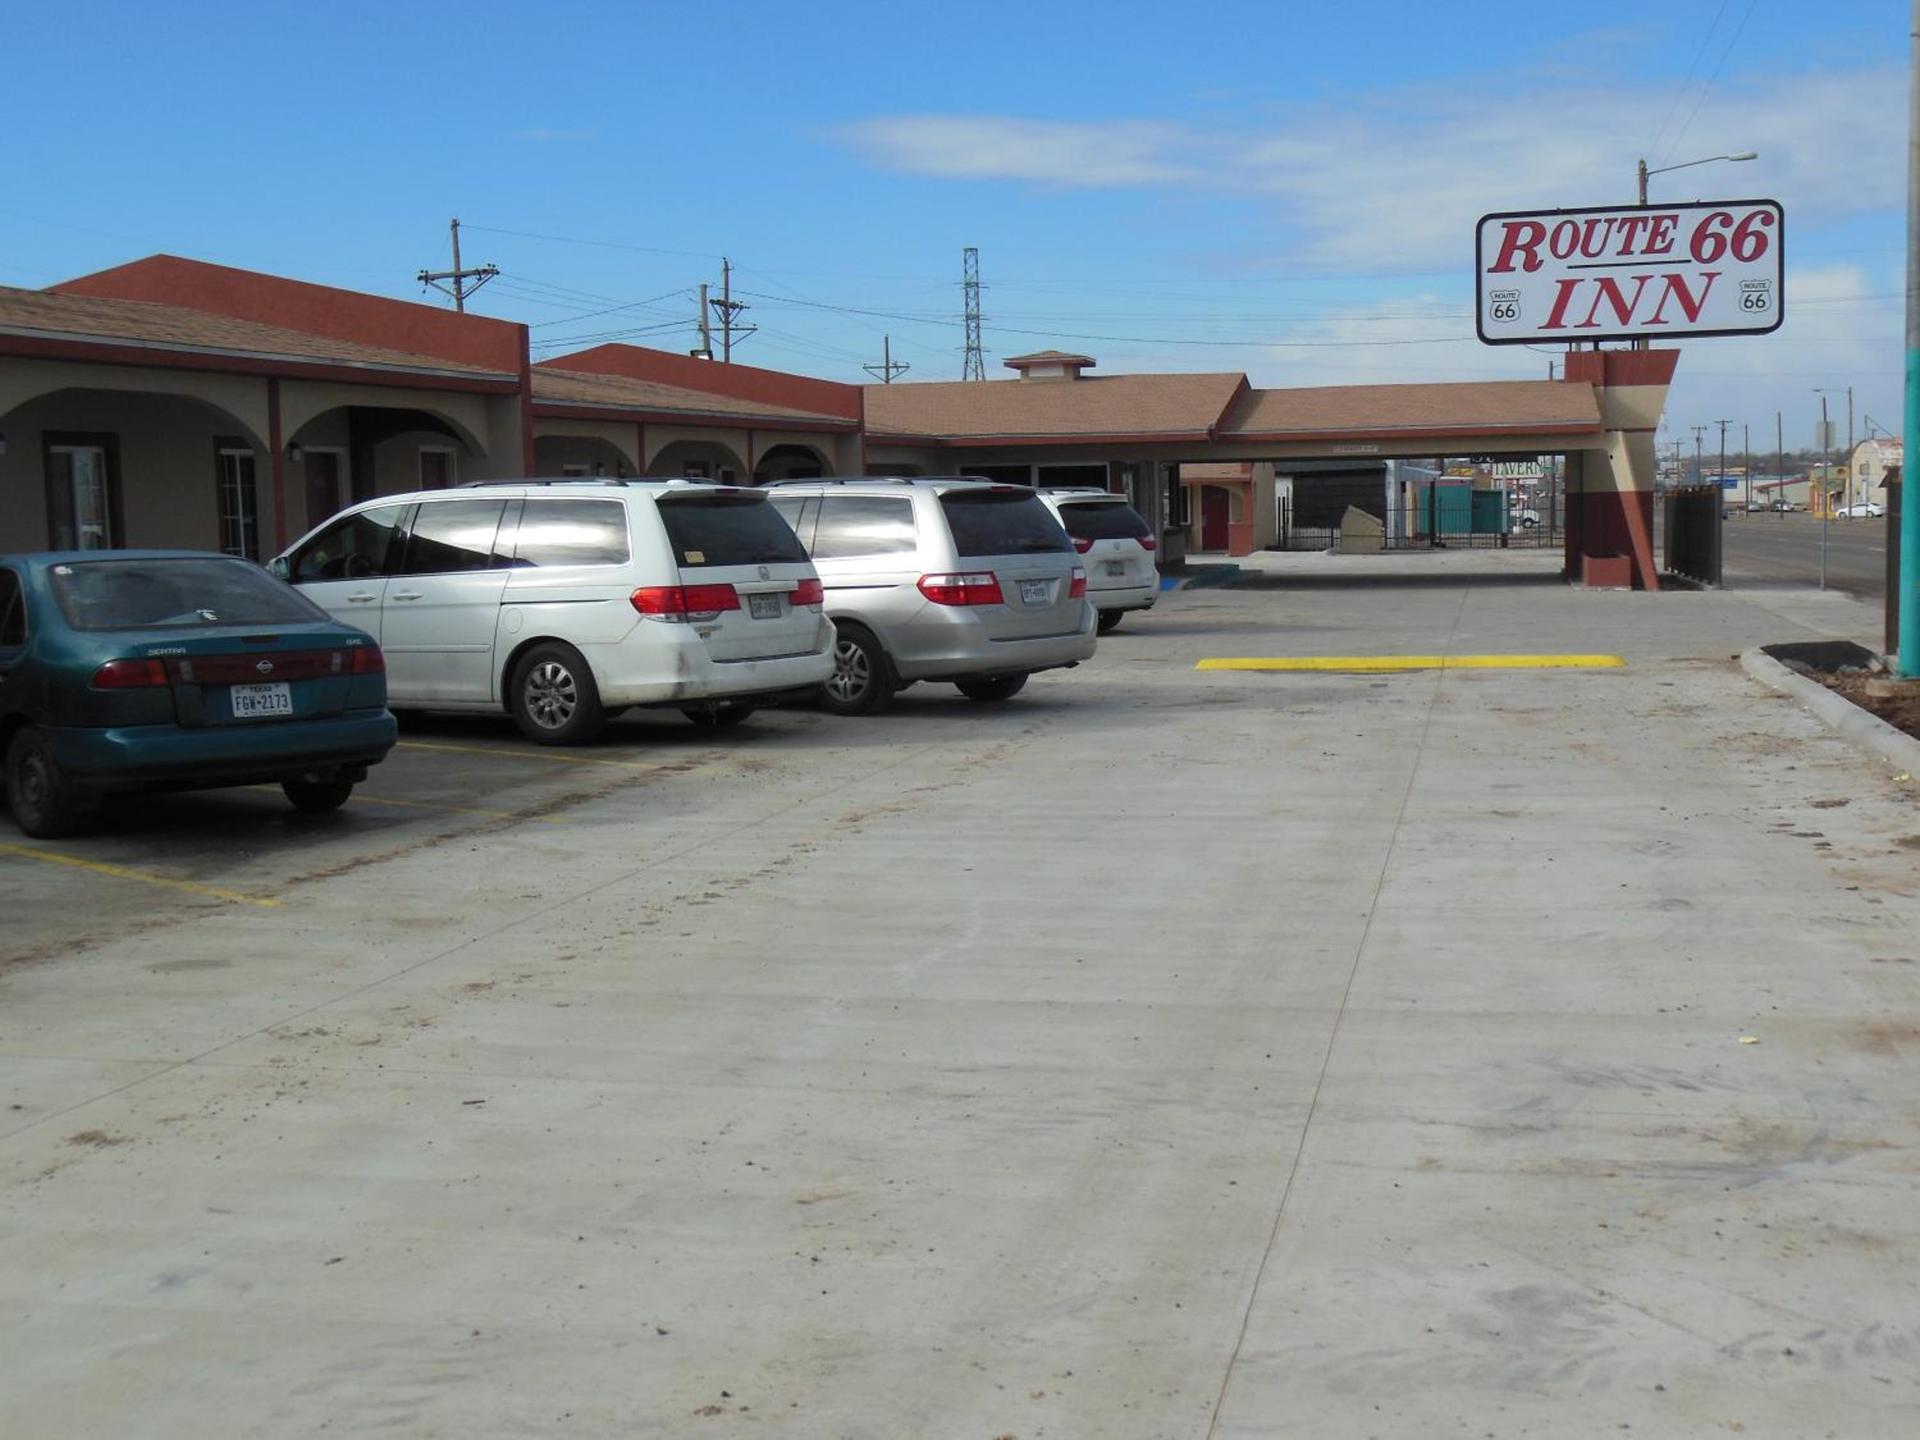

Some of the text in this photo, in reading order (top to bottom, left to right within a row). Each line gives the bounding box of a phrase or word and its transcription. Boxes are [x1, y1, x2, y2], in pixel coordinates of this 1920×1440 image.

[1487, 210, 1775, 273] ROUTE 66
[1494, 303, 1515, 319] 66
[1537, 272, 1722, 329] INN
[1743, 293, 1766, 309] 66
